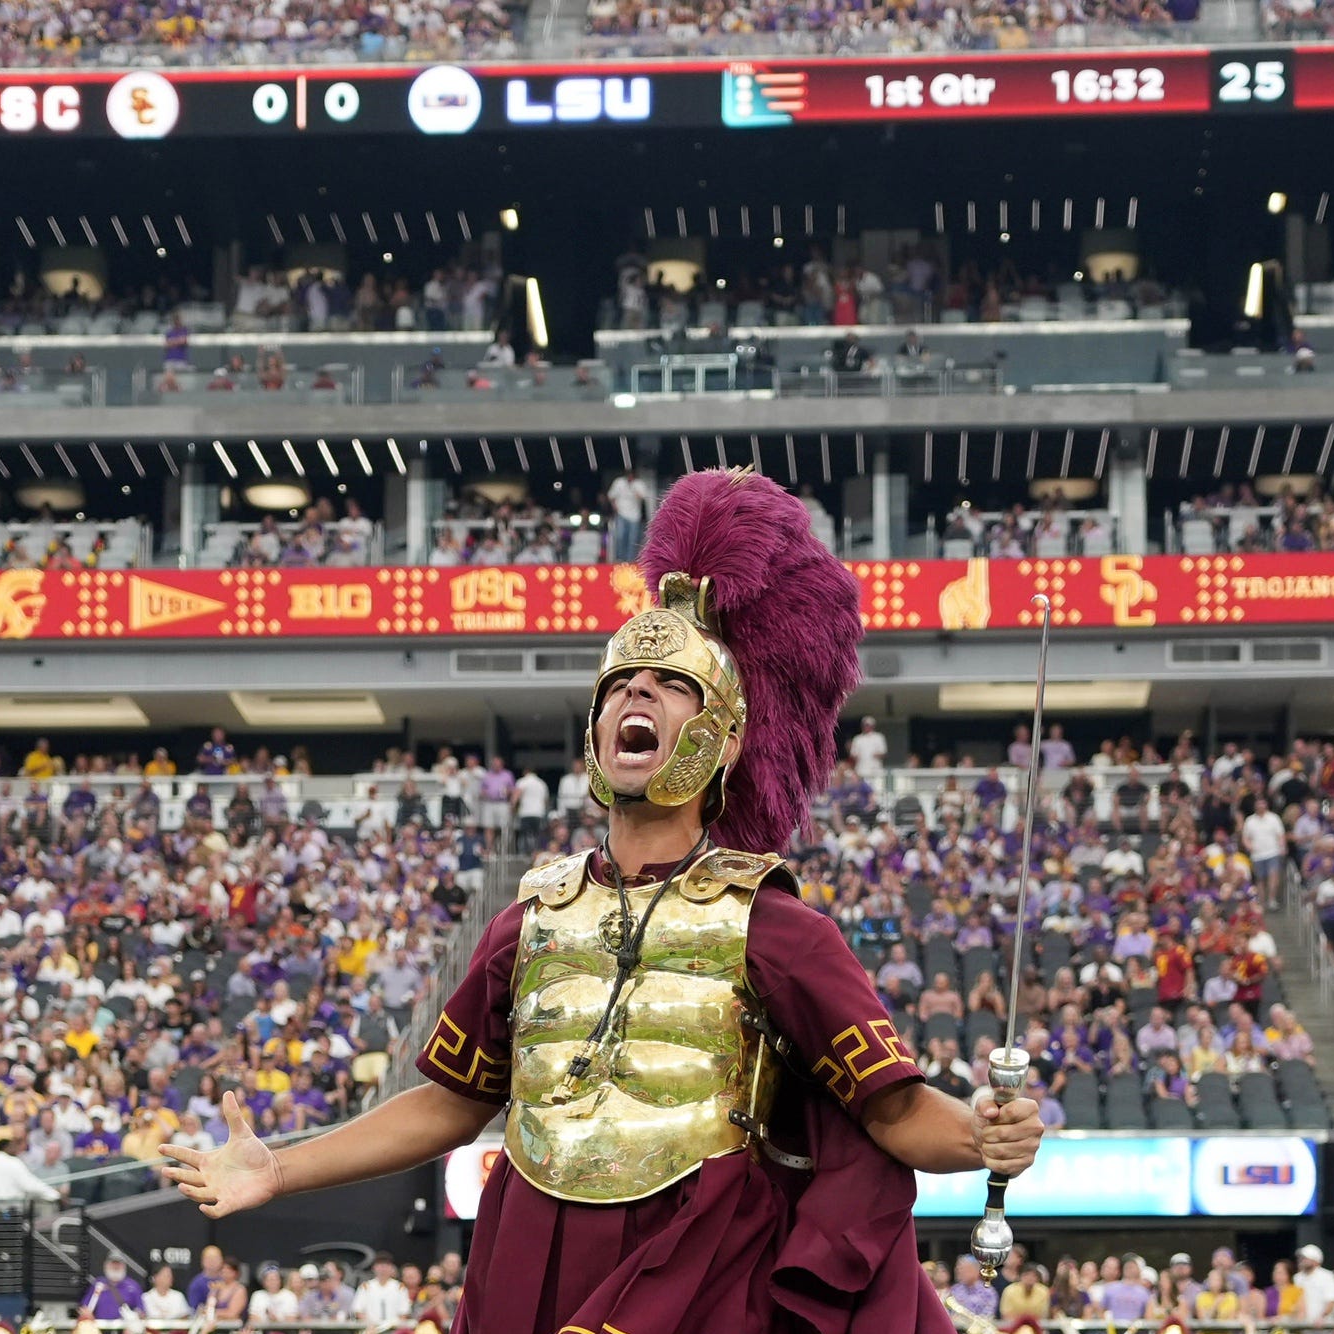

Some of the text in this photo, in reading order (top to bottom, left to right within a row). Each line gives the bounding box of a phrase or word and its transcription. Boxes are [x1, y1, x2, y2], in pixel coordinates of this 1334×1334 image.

[865, 72, 996, 107] 1st Qtr
[1051, 68, 1166, 103] 16:32
[1218, 61, 1286, 101] 25
[507, 77, 650, 123] LSU
[450, 568, 527, 611] USC
[1219, 1164, 1295, 1186] LSU
